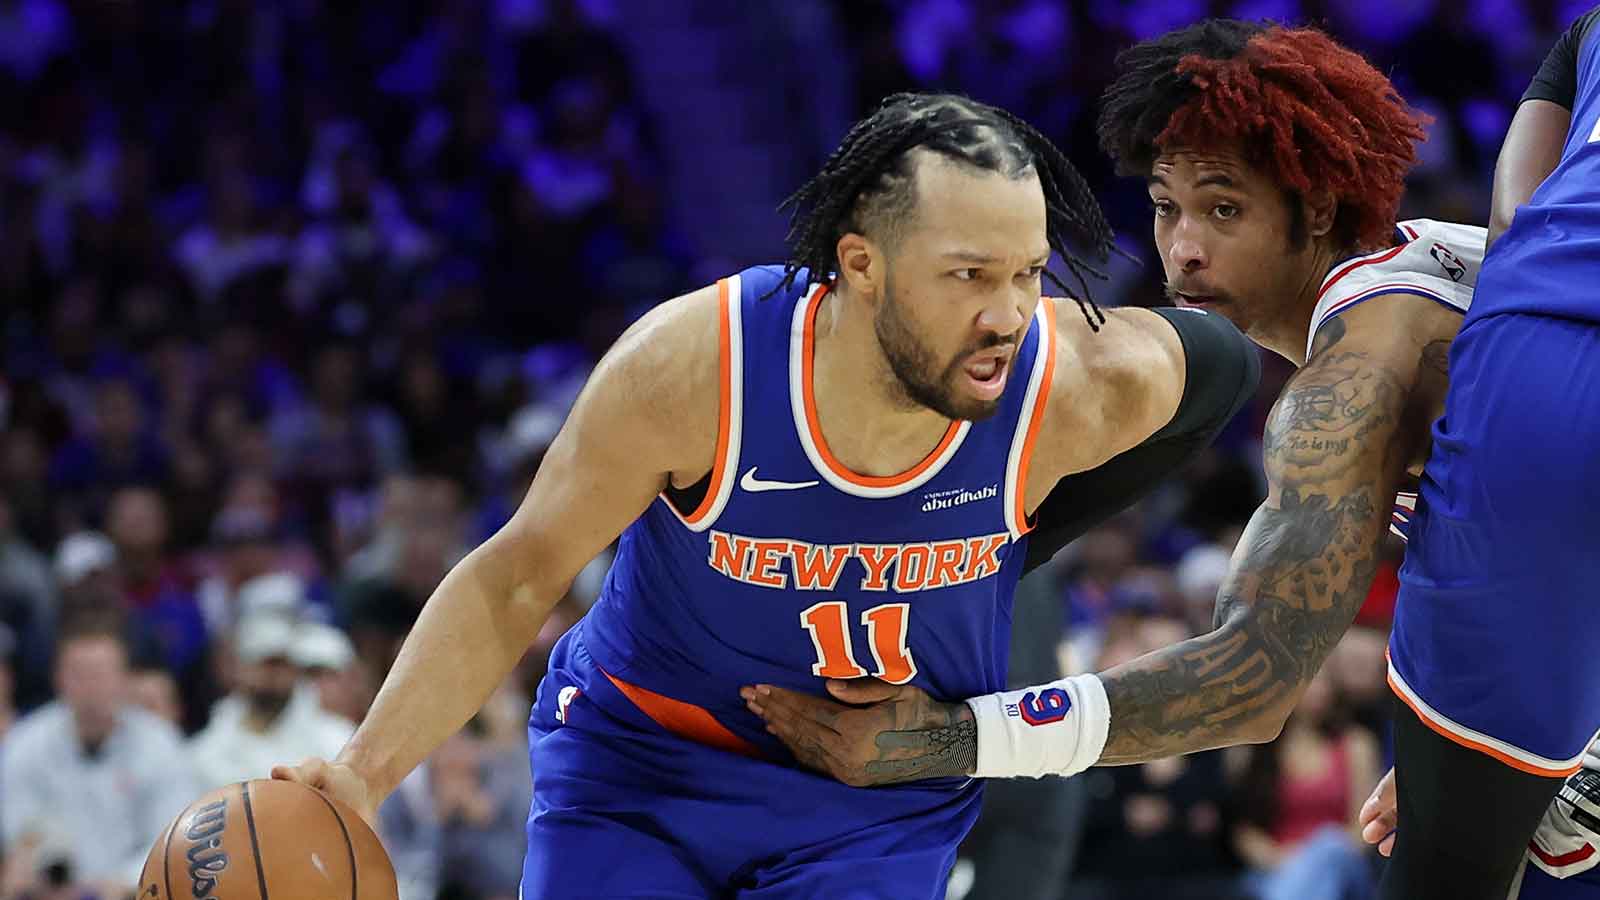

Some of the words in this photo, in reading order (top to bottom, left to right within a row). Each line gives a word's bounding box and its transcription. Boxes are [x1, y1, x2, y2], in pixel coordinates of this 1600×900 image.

[954, 484, 998, 505] dhabi
[709, 529, 852, 591] NEW
[855, 531, 1010, 593] YORK
[800, 601, 918, 685] 11
[1018, 688, 1072, 727] 9
[186, 799, 229, 900] Wils
